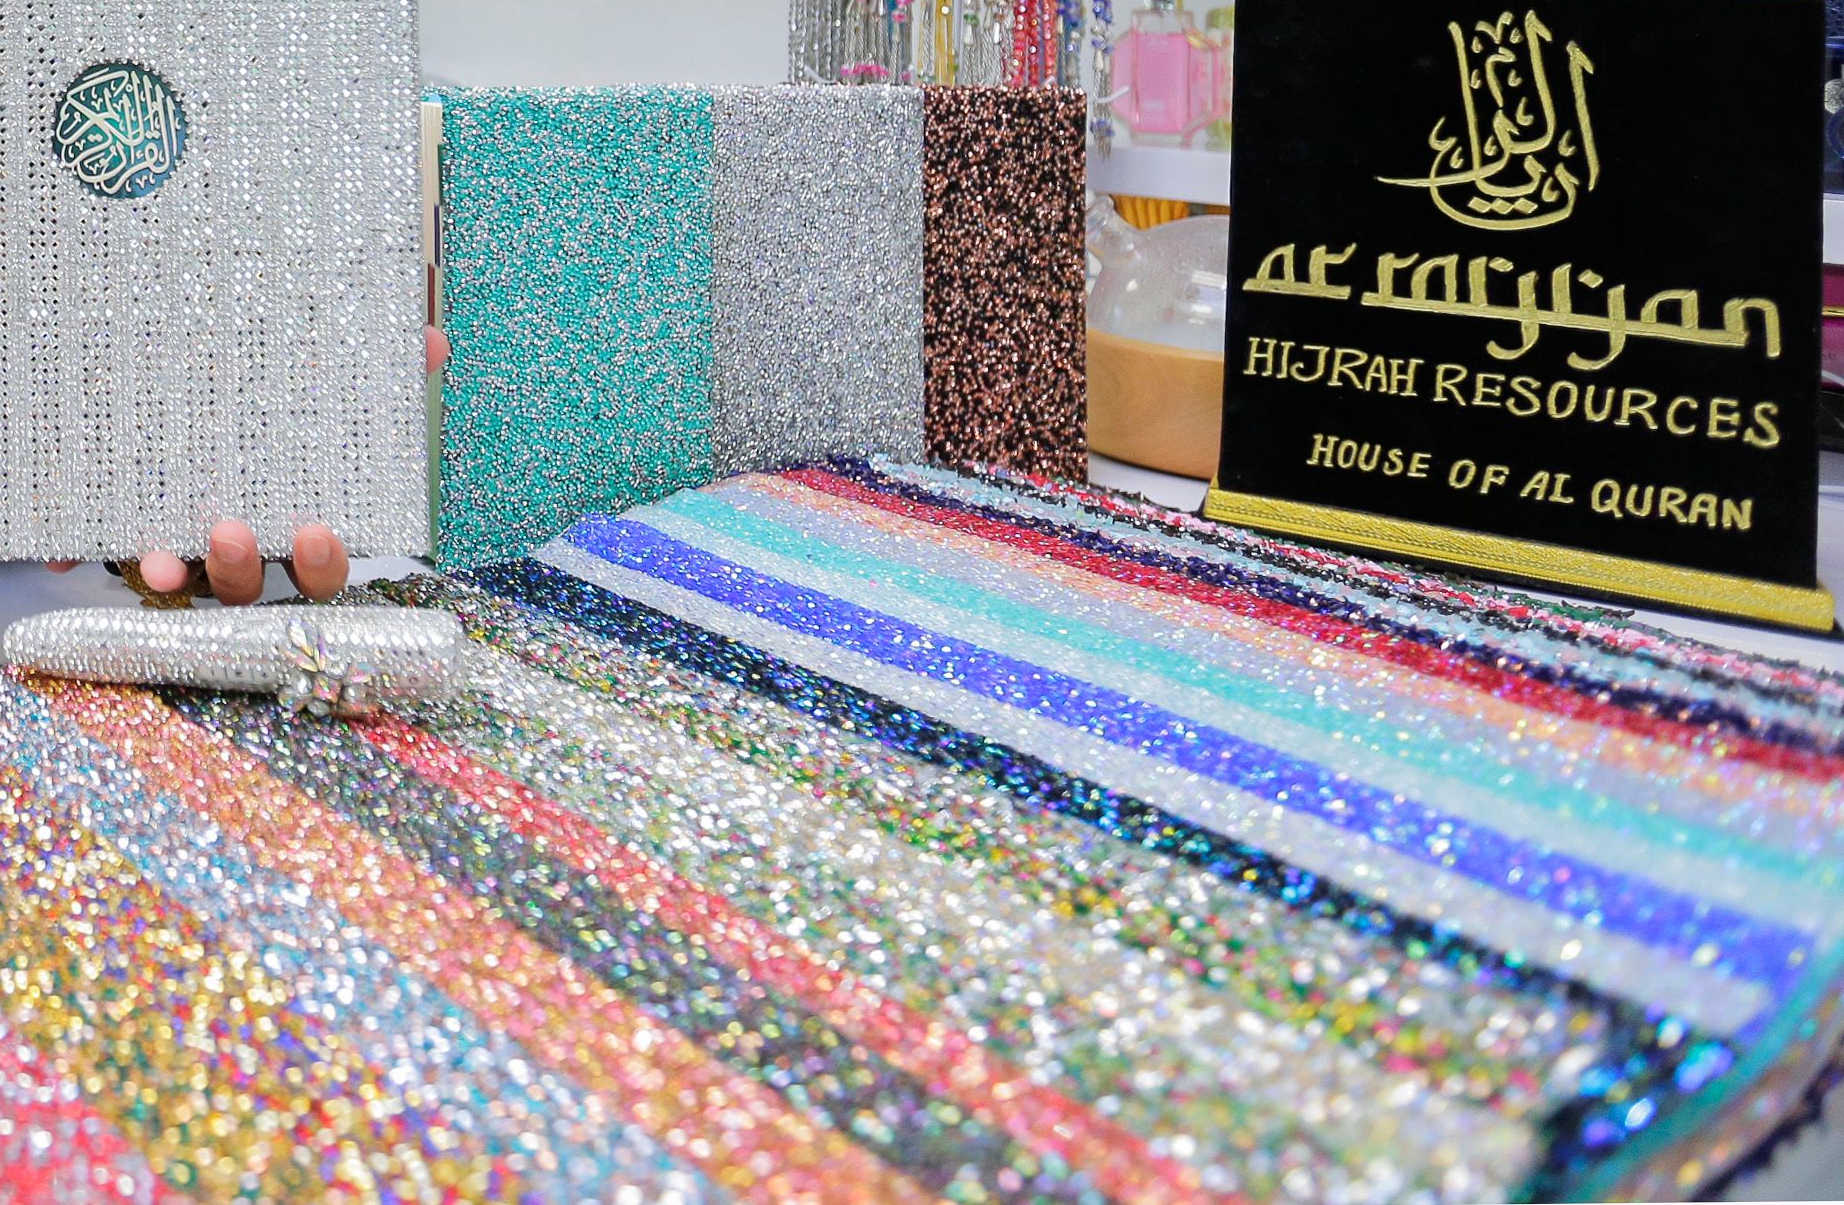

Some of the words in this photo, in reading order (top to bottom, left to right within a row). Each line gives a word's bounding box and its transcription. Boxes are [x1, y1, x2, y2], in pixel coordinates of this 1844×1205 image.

[1243, 337, 1424, 397] HIJRAH
[1433, 364, 1780, 448] RESOURCES
[1306, 434, 1432, 479] HOUSE
[1449, 459, 1509, 495] OF
[1520, 471, 1575, 504] AL
[1591, 479, 1753, 531] QURAN
